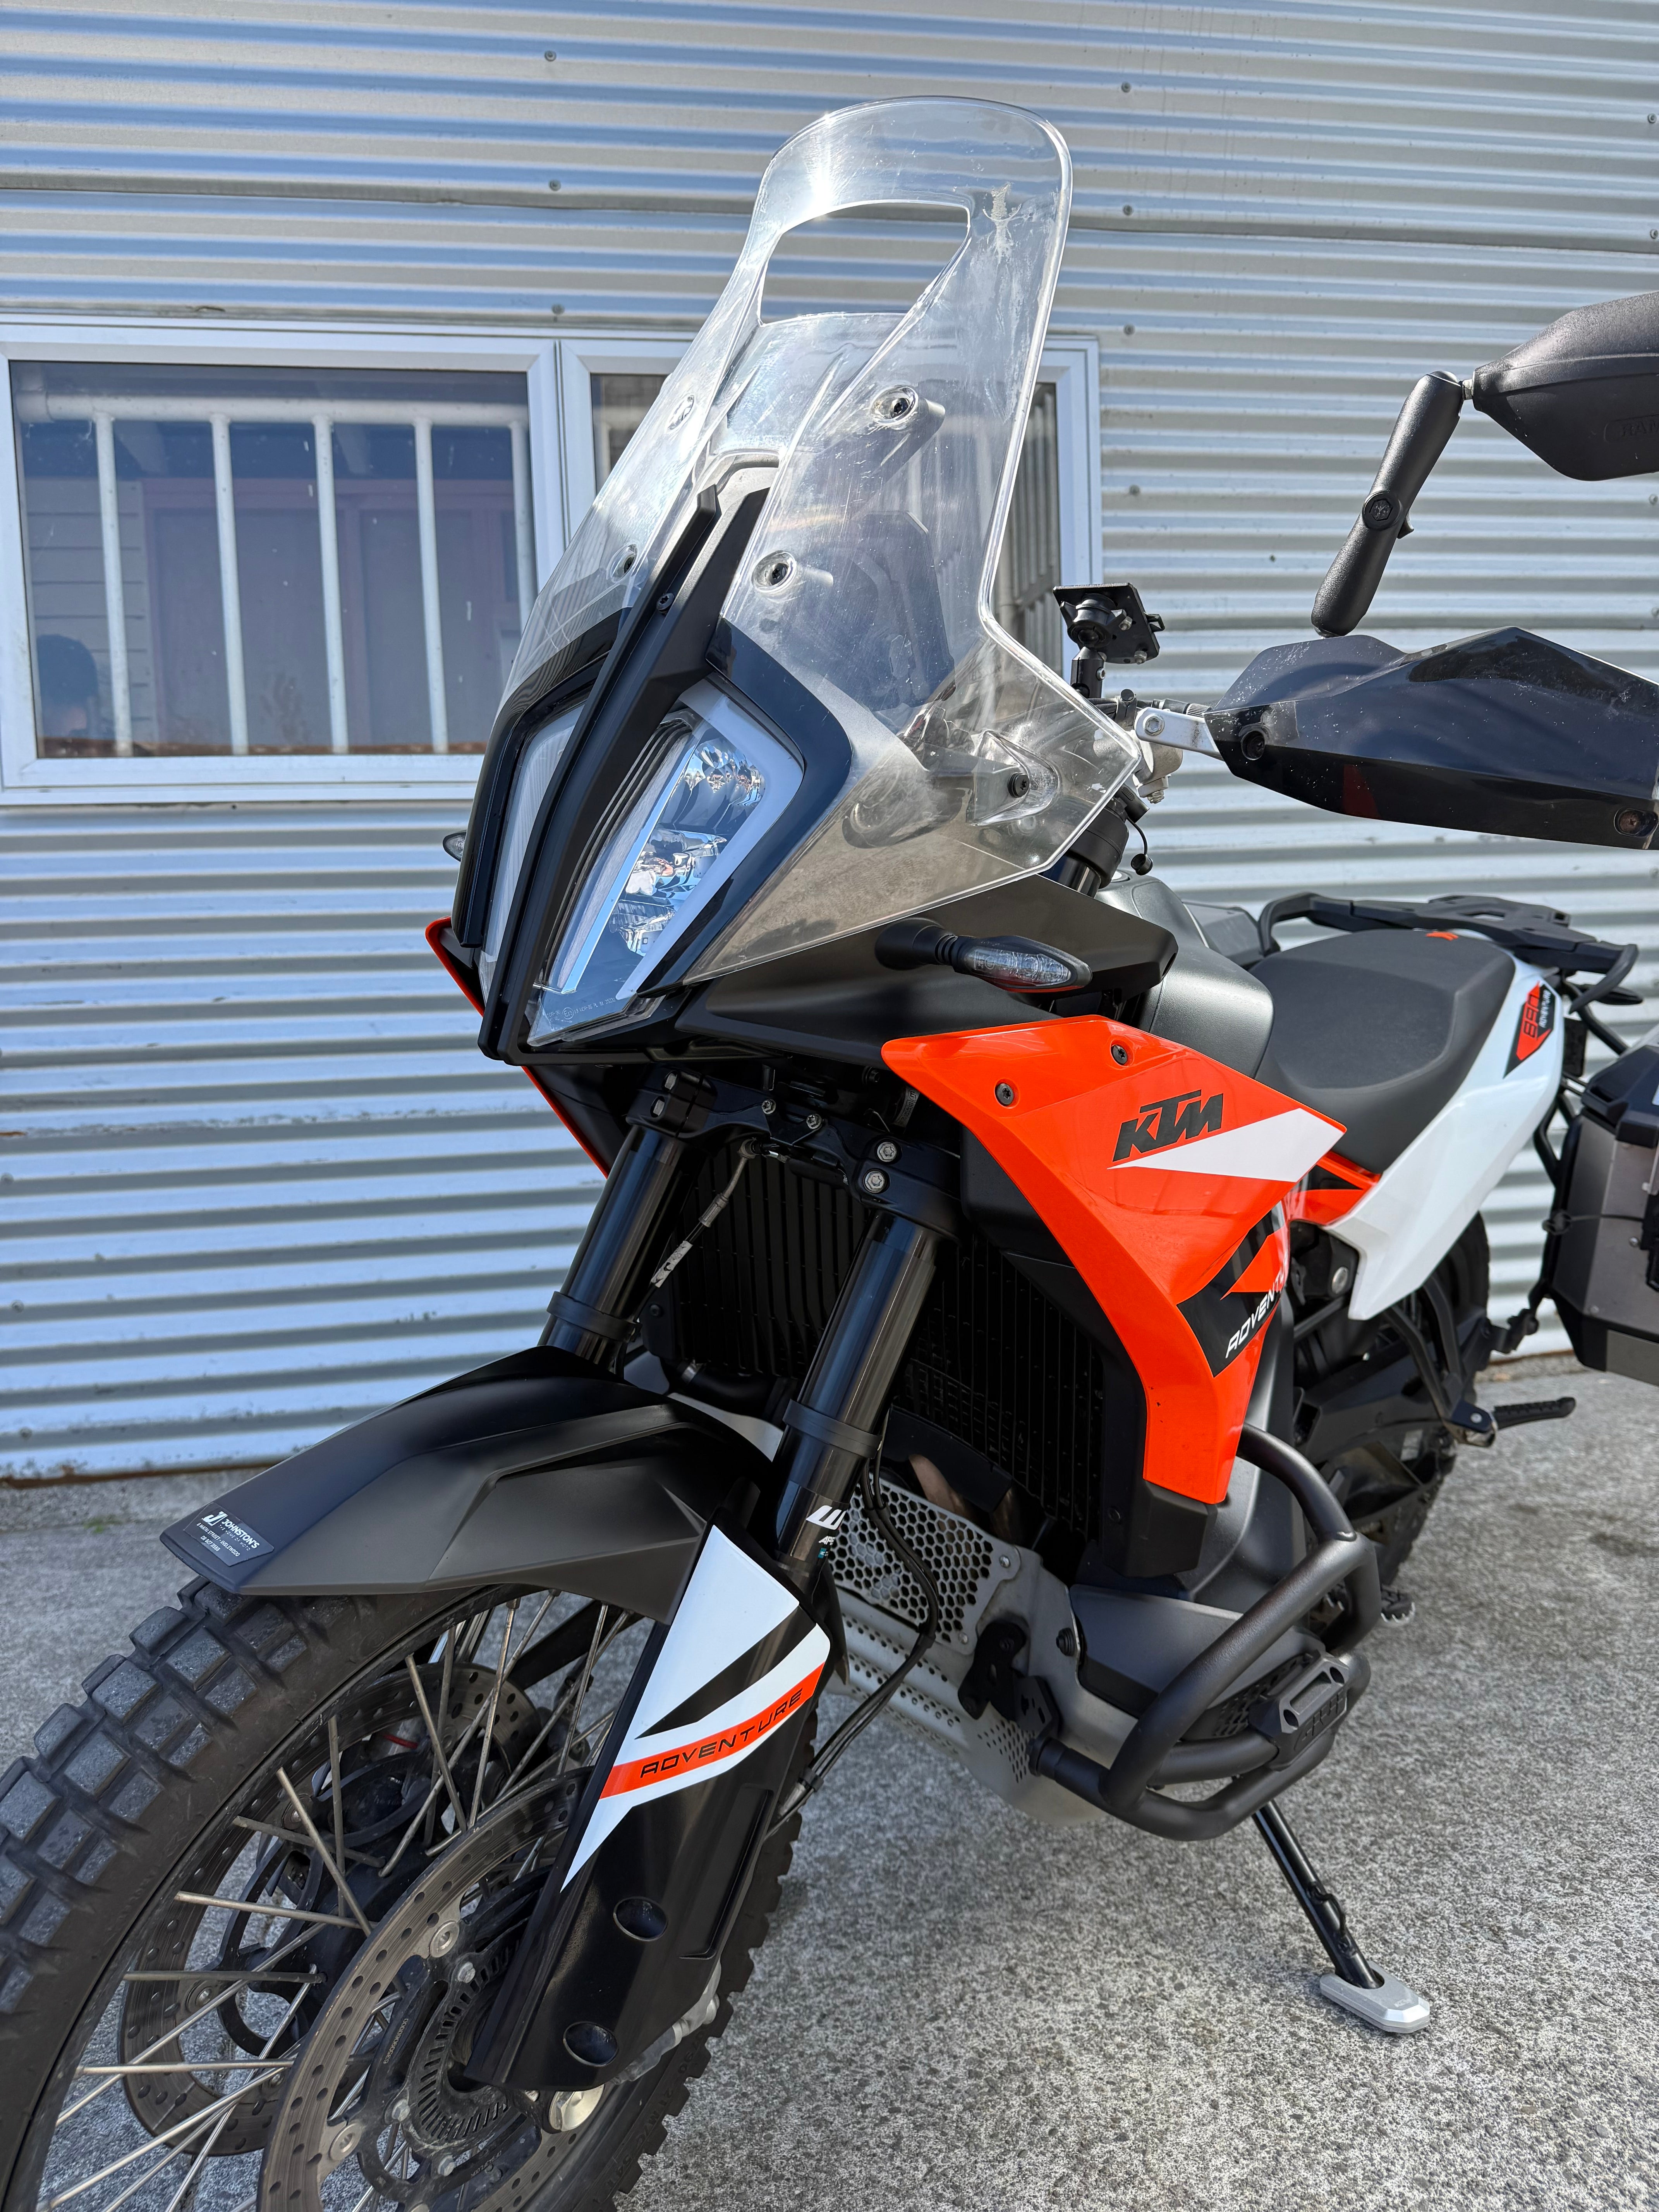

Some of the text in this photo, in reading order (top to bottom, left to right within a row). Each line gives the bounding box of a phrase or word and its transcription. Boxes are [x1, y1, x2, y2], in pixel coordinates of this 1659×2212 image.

[1113, 1089, 1224, 1162] KTM
[207, 1530, 221, 1540] STREET
[220, 1540, 240, 1557] INGLEWOOD
[221, 1518, 260, 1549] JOHNSTON'S
[640, 1687, 803, 1778] ADVENTURE
